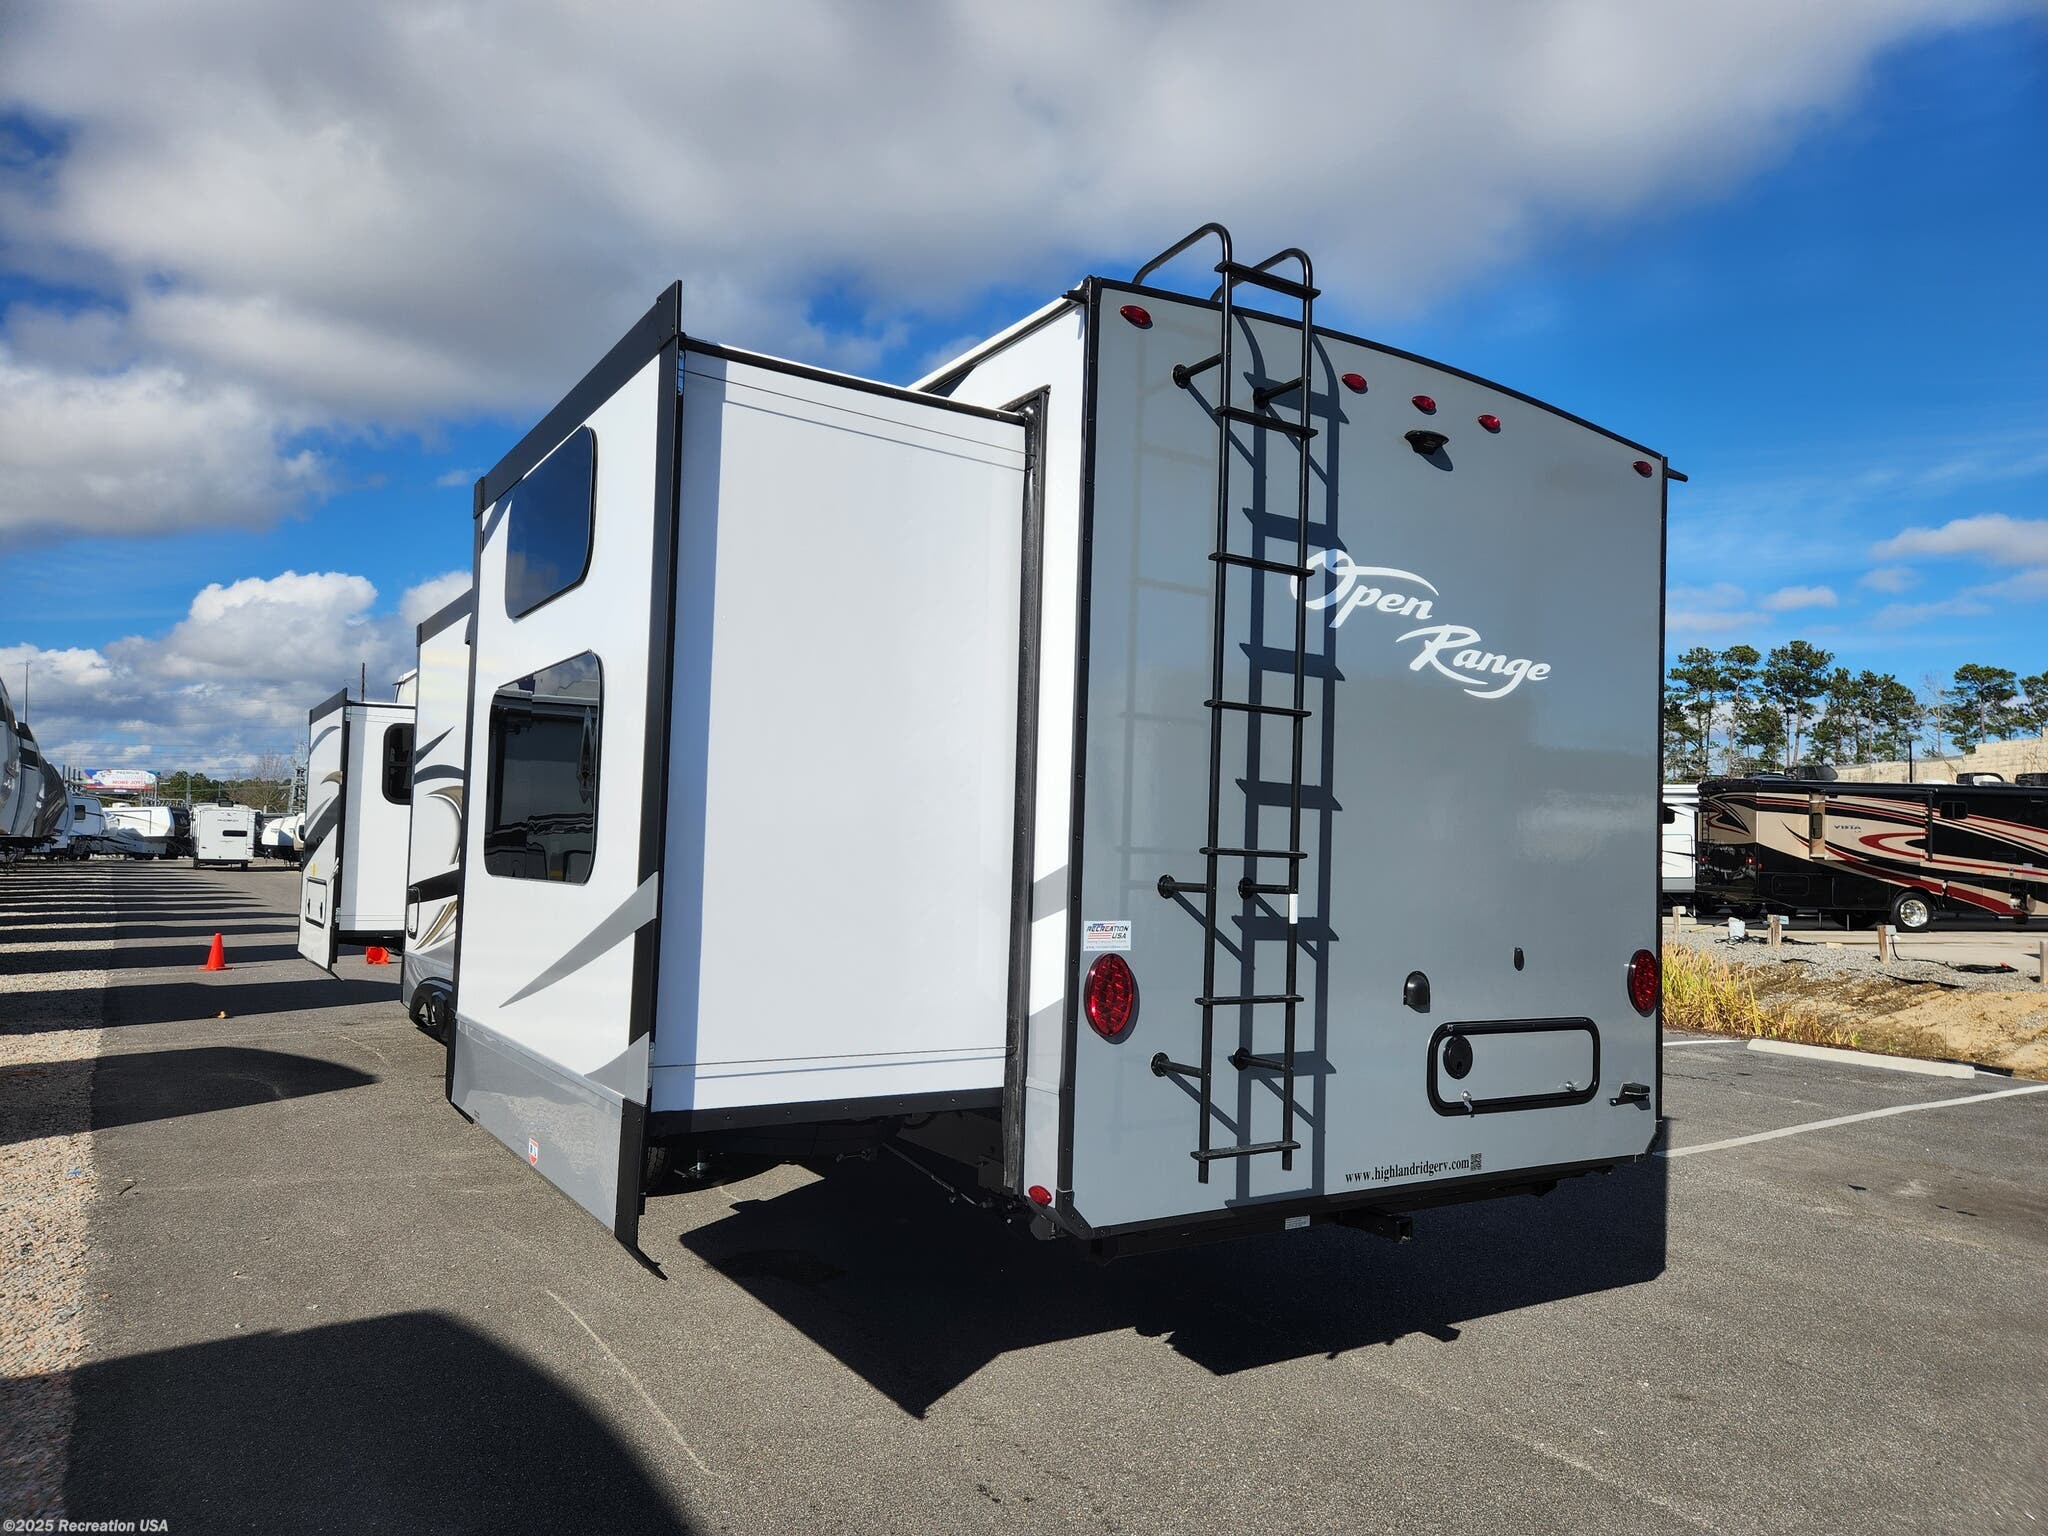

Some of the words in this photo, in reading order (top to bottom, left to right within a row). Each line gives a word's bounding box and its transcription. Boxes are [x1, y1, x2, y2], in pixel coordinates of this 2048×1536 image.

[1290, 549, 1440, 628] Open
[1396, 624, 1551, 699] Range
[1345, 1158, 1470, 1183] www.highlandridgerv.com
